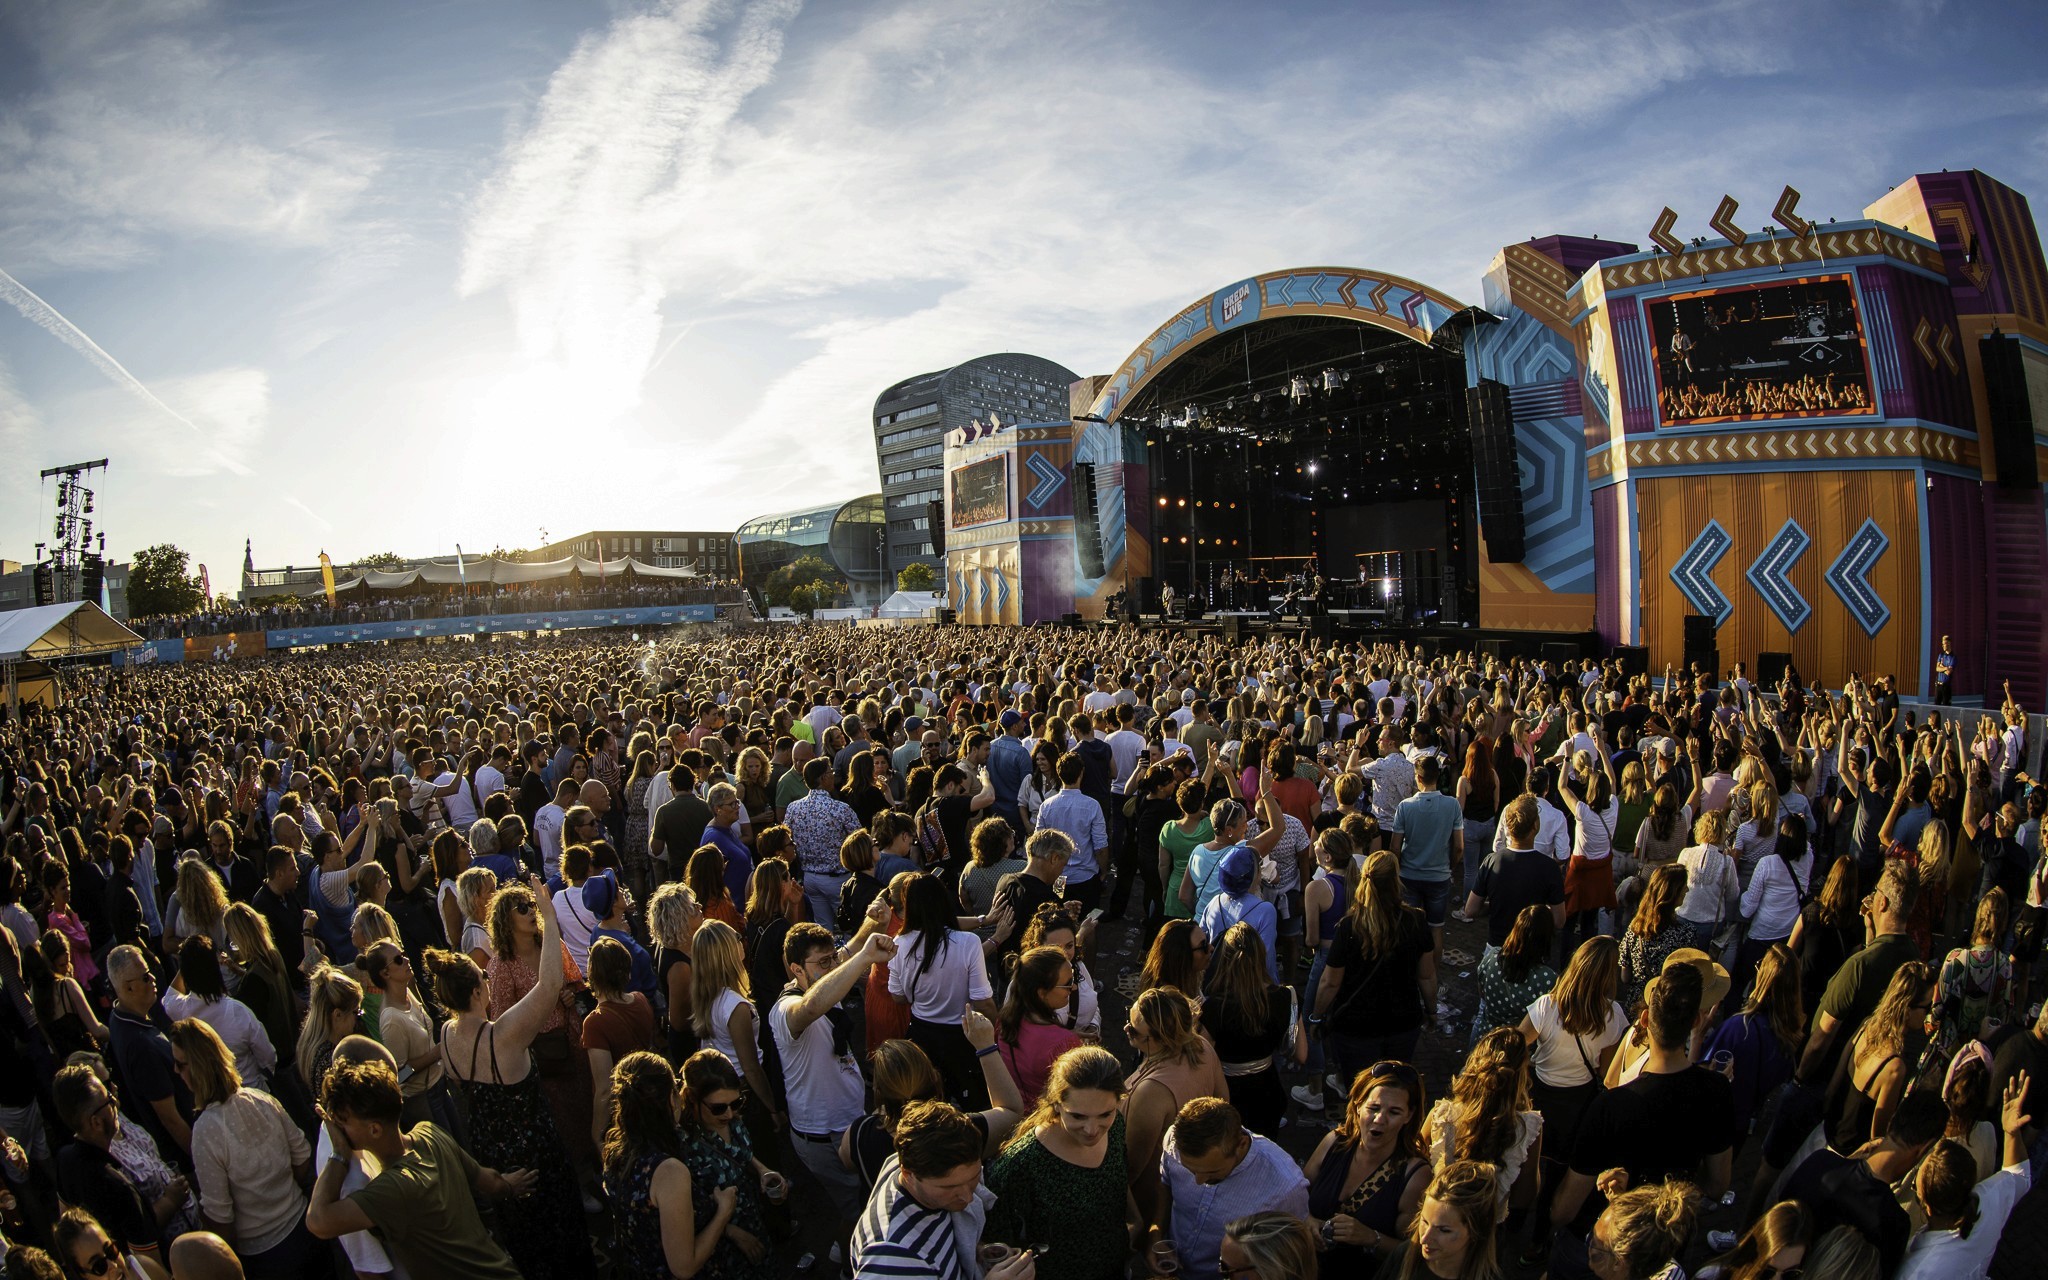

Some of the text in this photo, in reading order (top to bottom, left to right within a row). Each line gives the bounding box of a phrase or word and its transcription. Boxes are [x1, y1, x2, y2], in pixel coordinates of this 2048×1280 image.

[1223, 284, 1250, 310] BREDA
[1224, 300, 1243, 321] LIVE
[135, 647, 158, 664] BREDA
